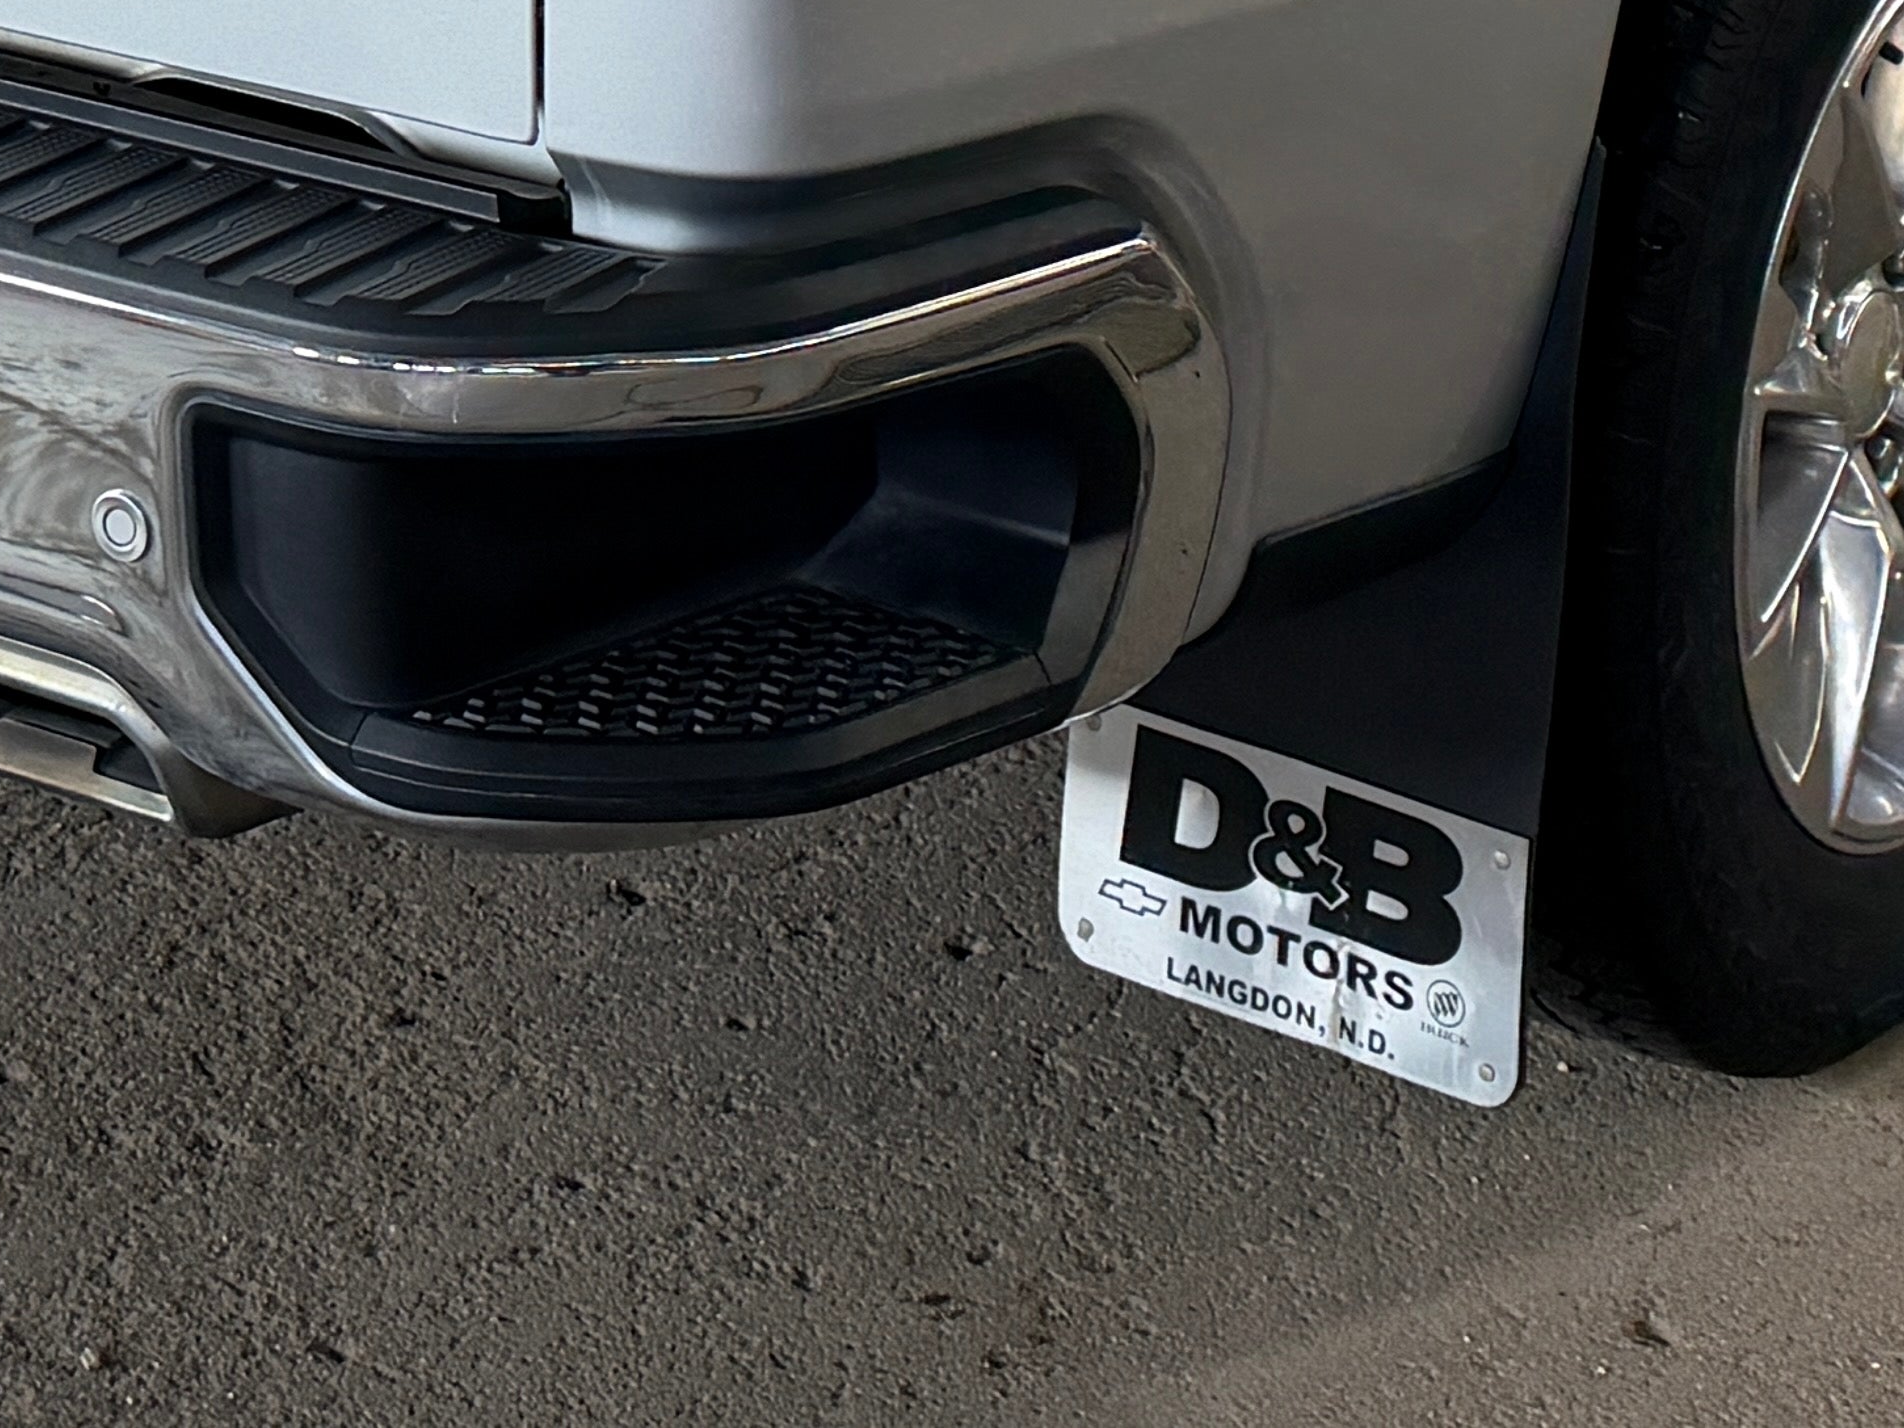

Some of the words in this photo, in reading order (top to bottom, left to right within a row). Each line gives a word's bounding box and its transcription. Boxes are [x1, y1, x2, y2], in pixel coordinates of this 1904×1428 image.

[1119, 723, 1464, 966] D&B
[1166, 956, 1327, 1037] LANGDON,
[1338, 1015, 1395, 1061] N.D.
[1179, 896, 1415, 1012] MOTORS
